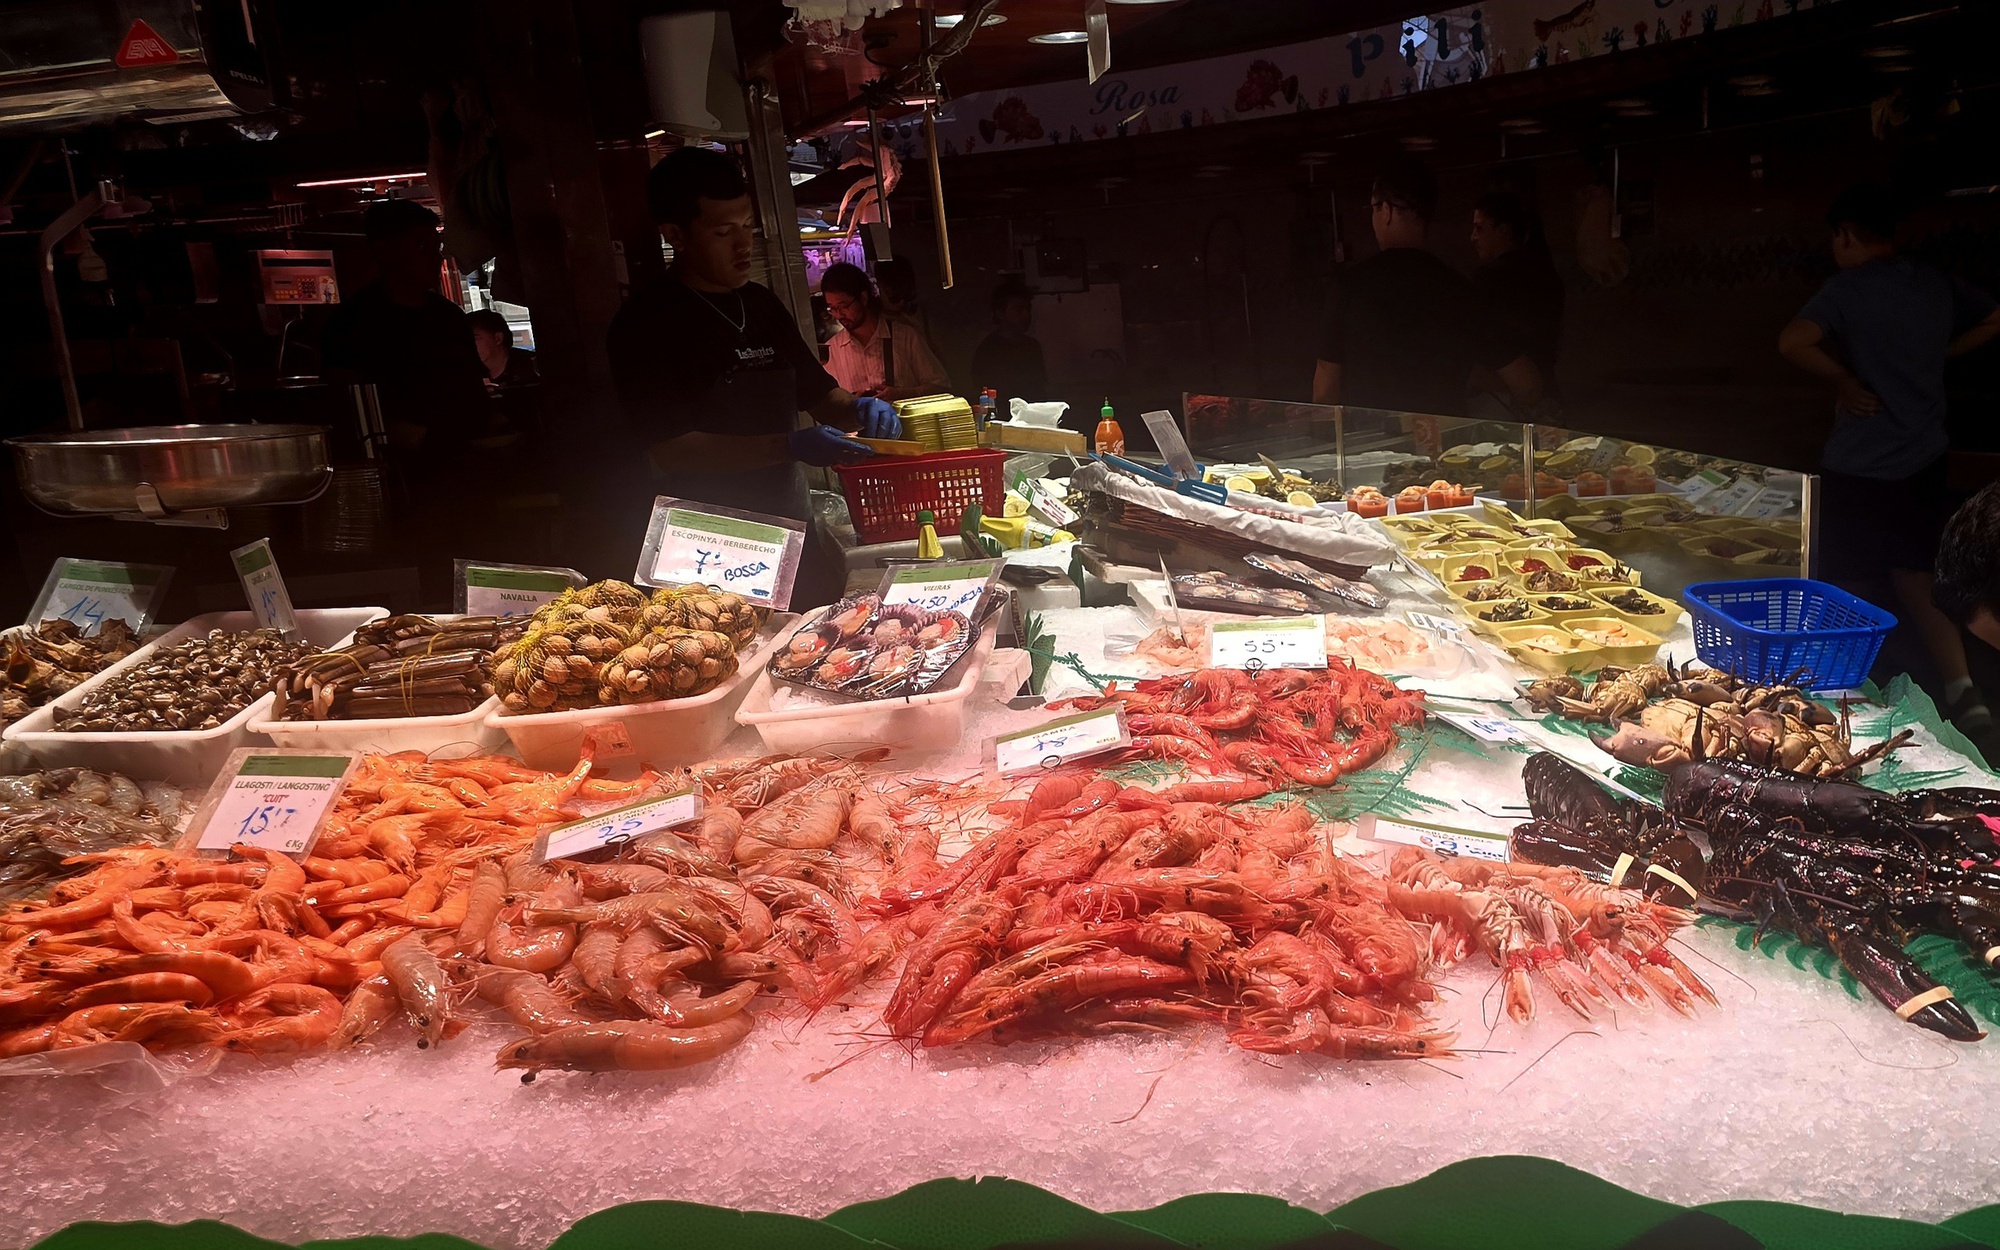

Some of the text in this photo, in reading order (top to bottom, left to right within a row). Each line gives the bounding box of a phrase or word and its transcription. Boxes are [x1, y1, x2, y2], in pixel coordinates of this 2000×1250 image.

[1345, 10, 1484, 79] pili
[1089, 80, 1184, 115] Rosa
[671, 529, 717, 545] ESCOPINYA
[723, 540, 776, 554] BERBERECHO
[724, 561, 770, 581] BOSSA
[923, 584, 951, 592] VIEIRAS
[500, 592, 538, 602] NAVALLA
[1032, 726, 1076, 739] GAMBA
[234, 780, 273, 790] LLAGOSTI
